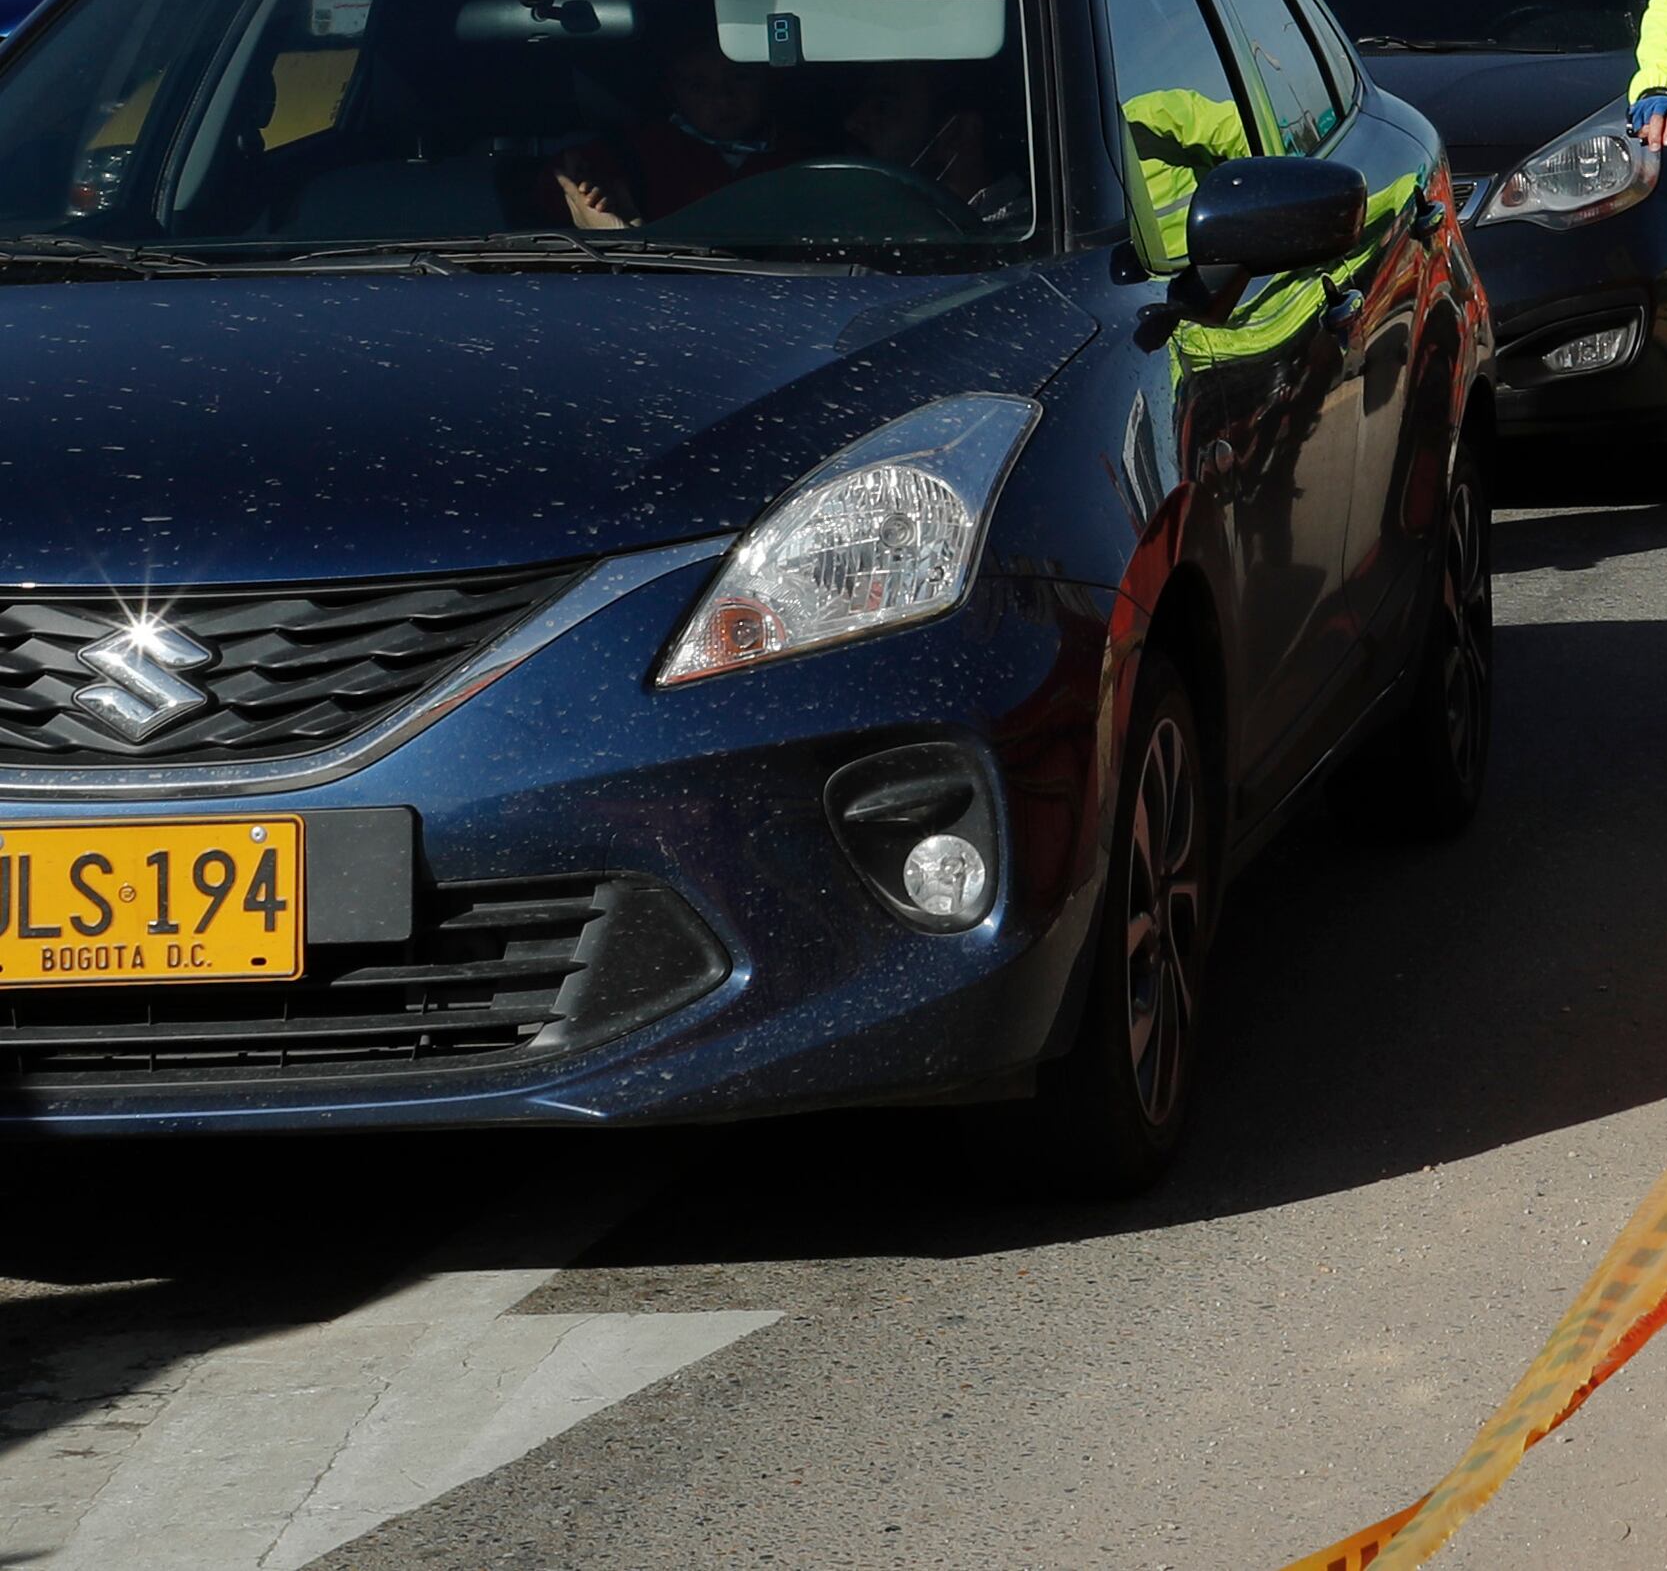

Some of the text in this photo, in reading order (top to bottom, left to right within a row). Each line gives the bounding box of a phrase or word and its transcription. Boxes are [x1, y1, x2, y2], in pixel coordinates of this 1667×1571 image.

[0, 848, 288, 942] LS 194
[41, 942, 213, 972] BOGOTA D.C.
